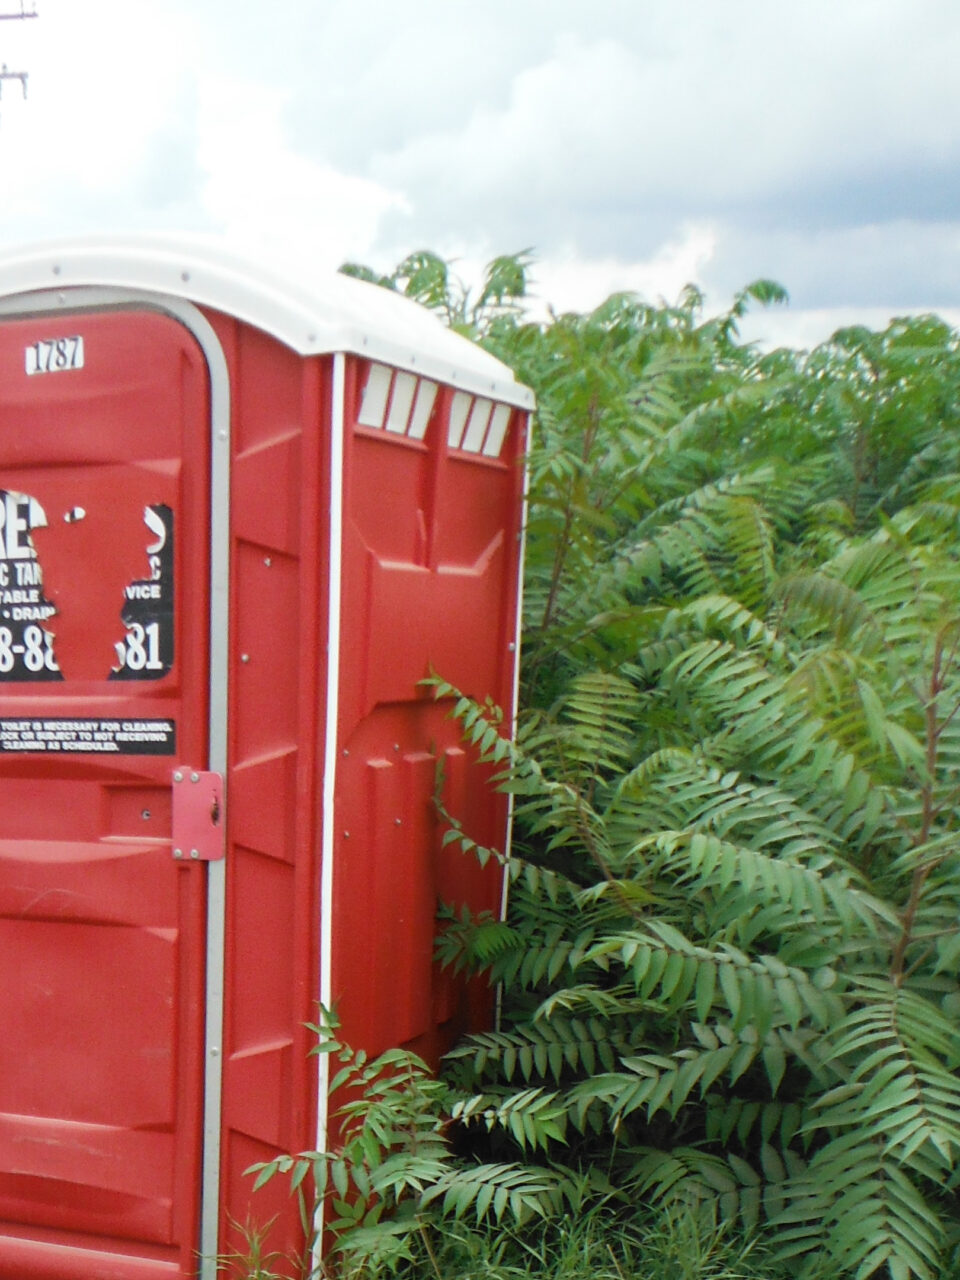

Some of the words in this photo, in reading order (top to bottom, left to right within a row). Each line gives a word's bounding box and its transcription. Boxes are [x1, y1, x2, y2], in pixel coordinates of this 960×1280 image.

[33, 337, 80, 371] 1787
[1, 722, 31, 731] TOILET
[43, 722, 99, 731] NECESSARY
[100, 722, 120, 731] FOR
[20, 731, 35, 740] OR
[78, 731, 92, 740] TO
[94, 732, 114, 741] NOT
[115, 732, 168, 741] RECEIVING
[2, 740, 46, 750] CLEANING
[47, 741, 60, 750] AS
